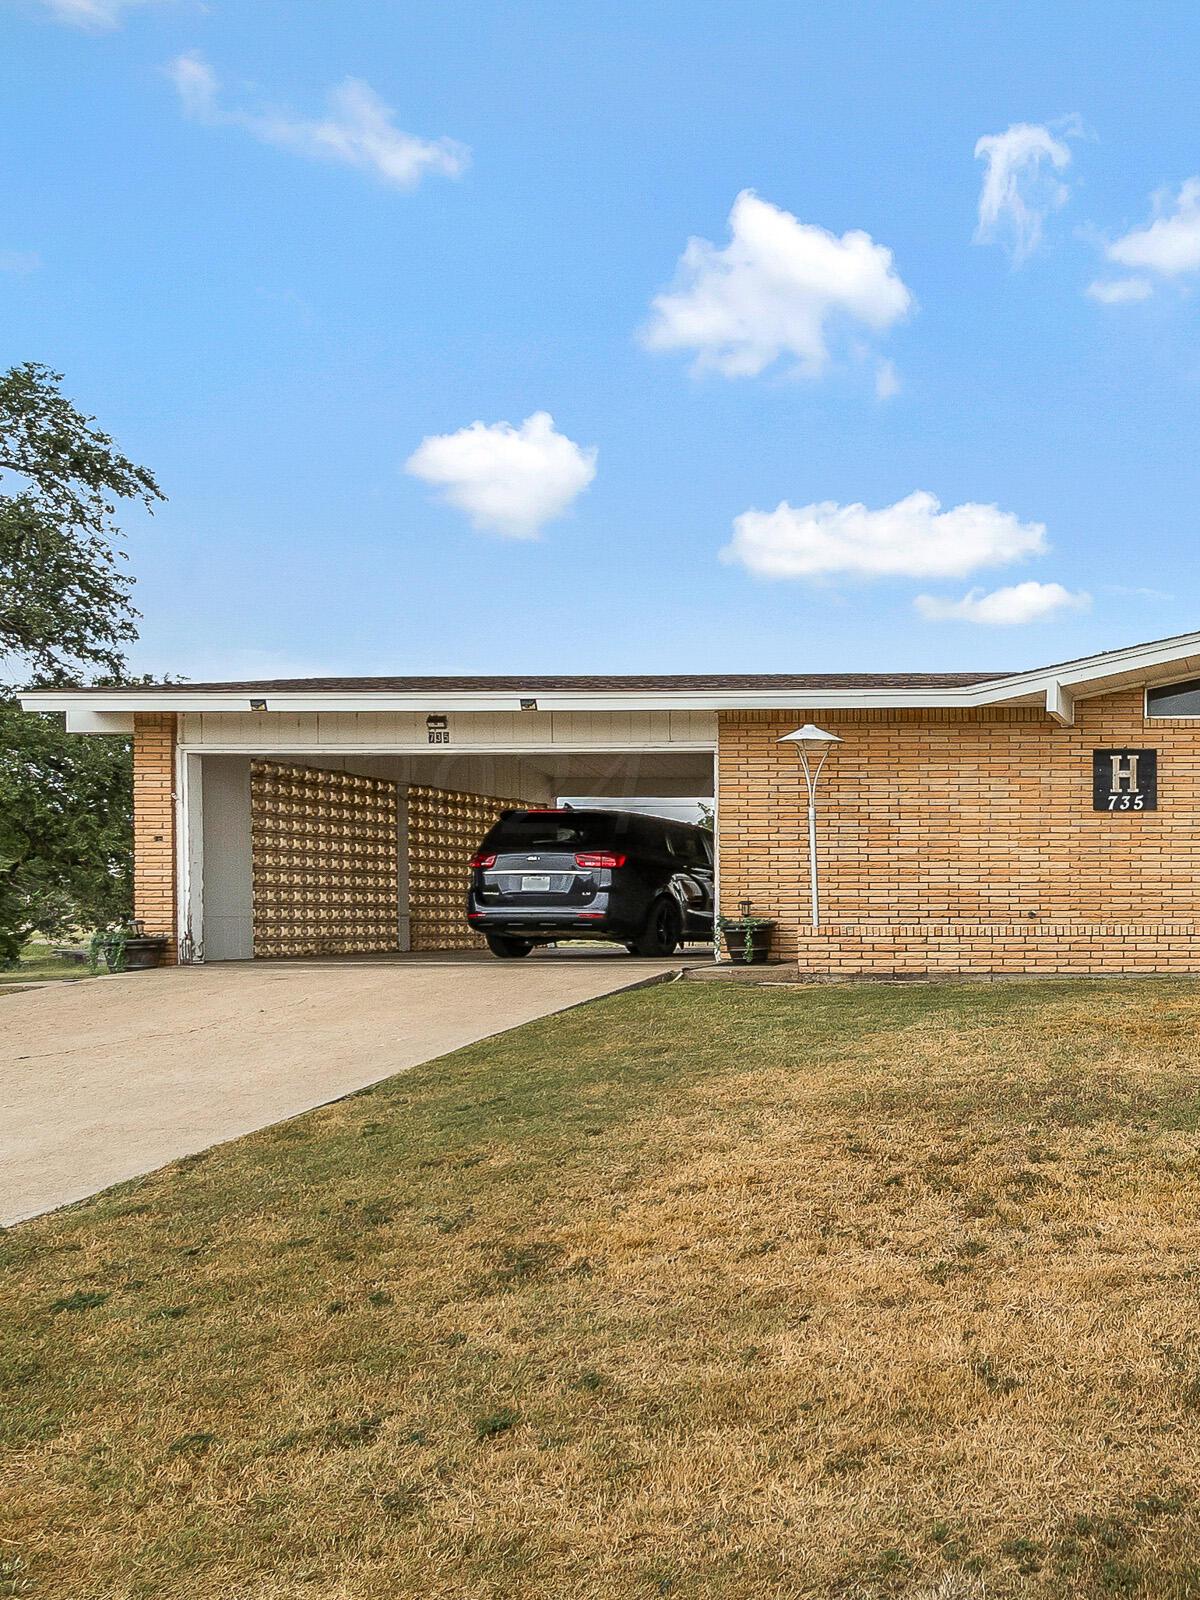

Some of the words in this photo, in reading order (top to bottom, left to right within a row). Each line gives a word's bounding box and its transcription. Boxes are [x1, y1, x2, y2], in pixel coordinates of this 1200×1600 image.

[429, 732, 449, 743] 735
[1110, 755, 1139, 793] H
[1108, 795, 1144, 810] 735
